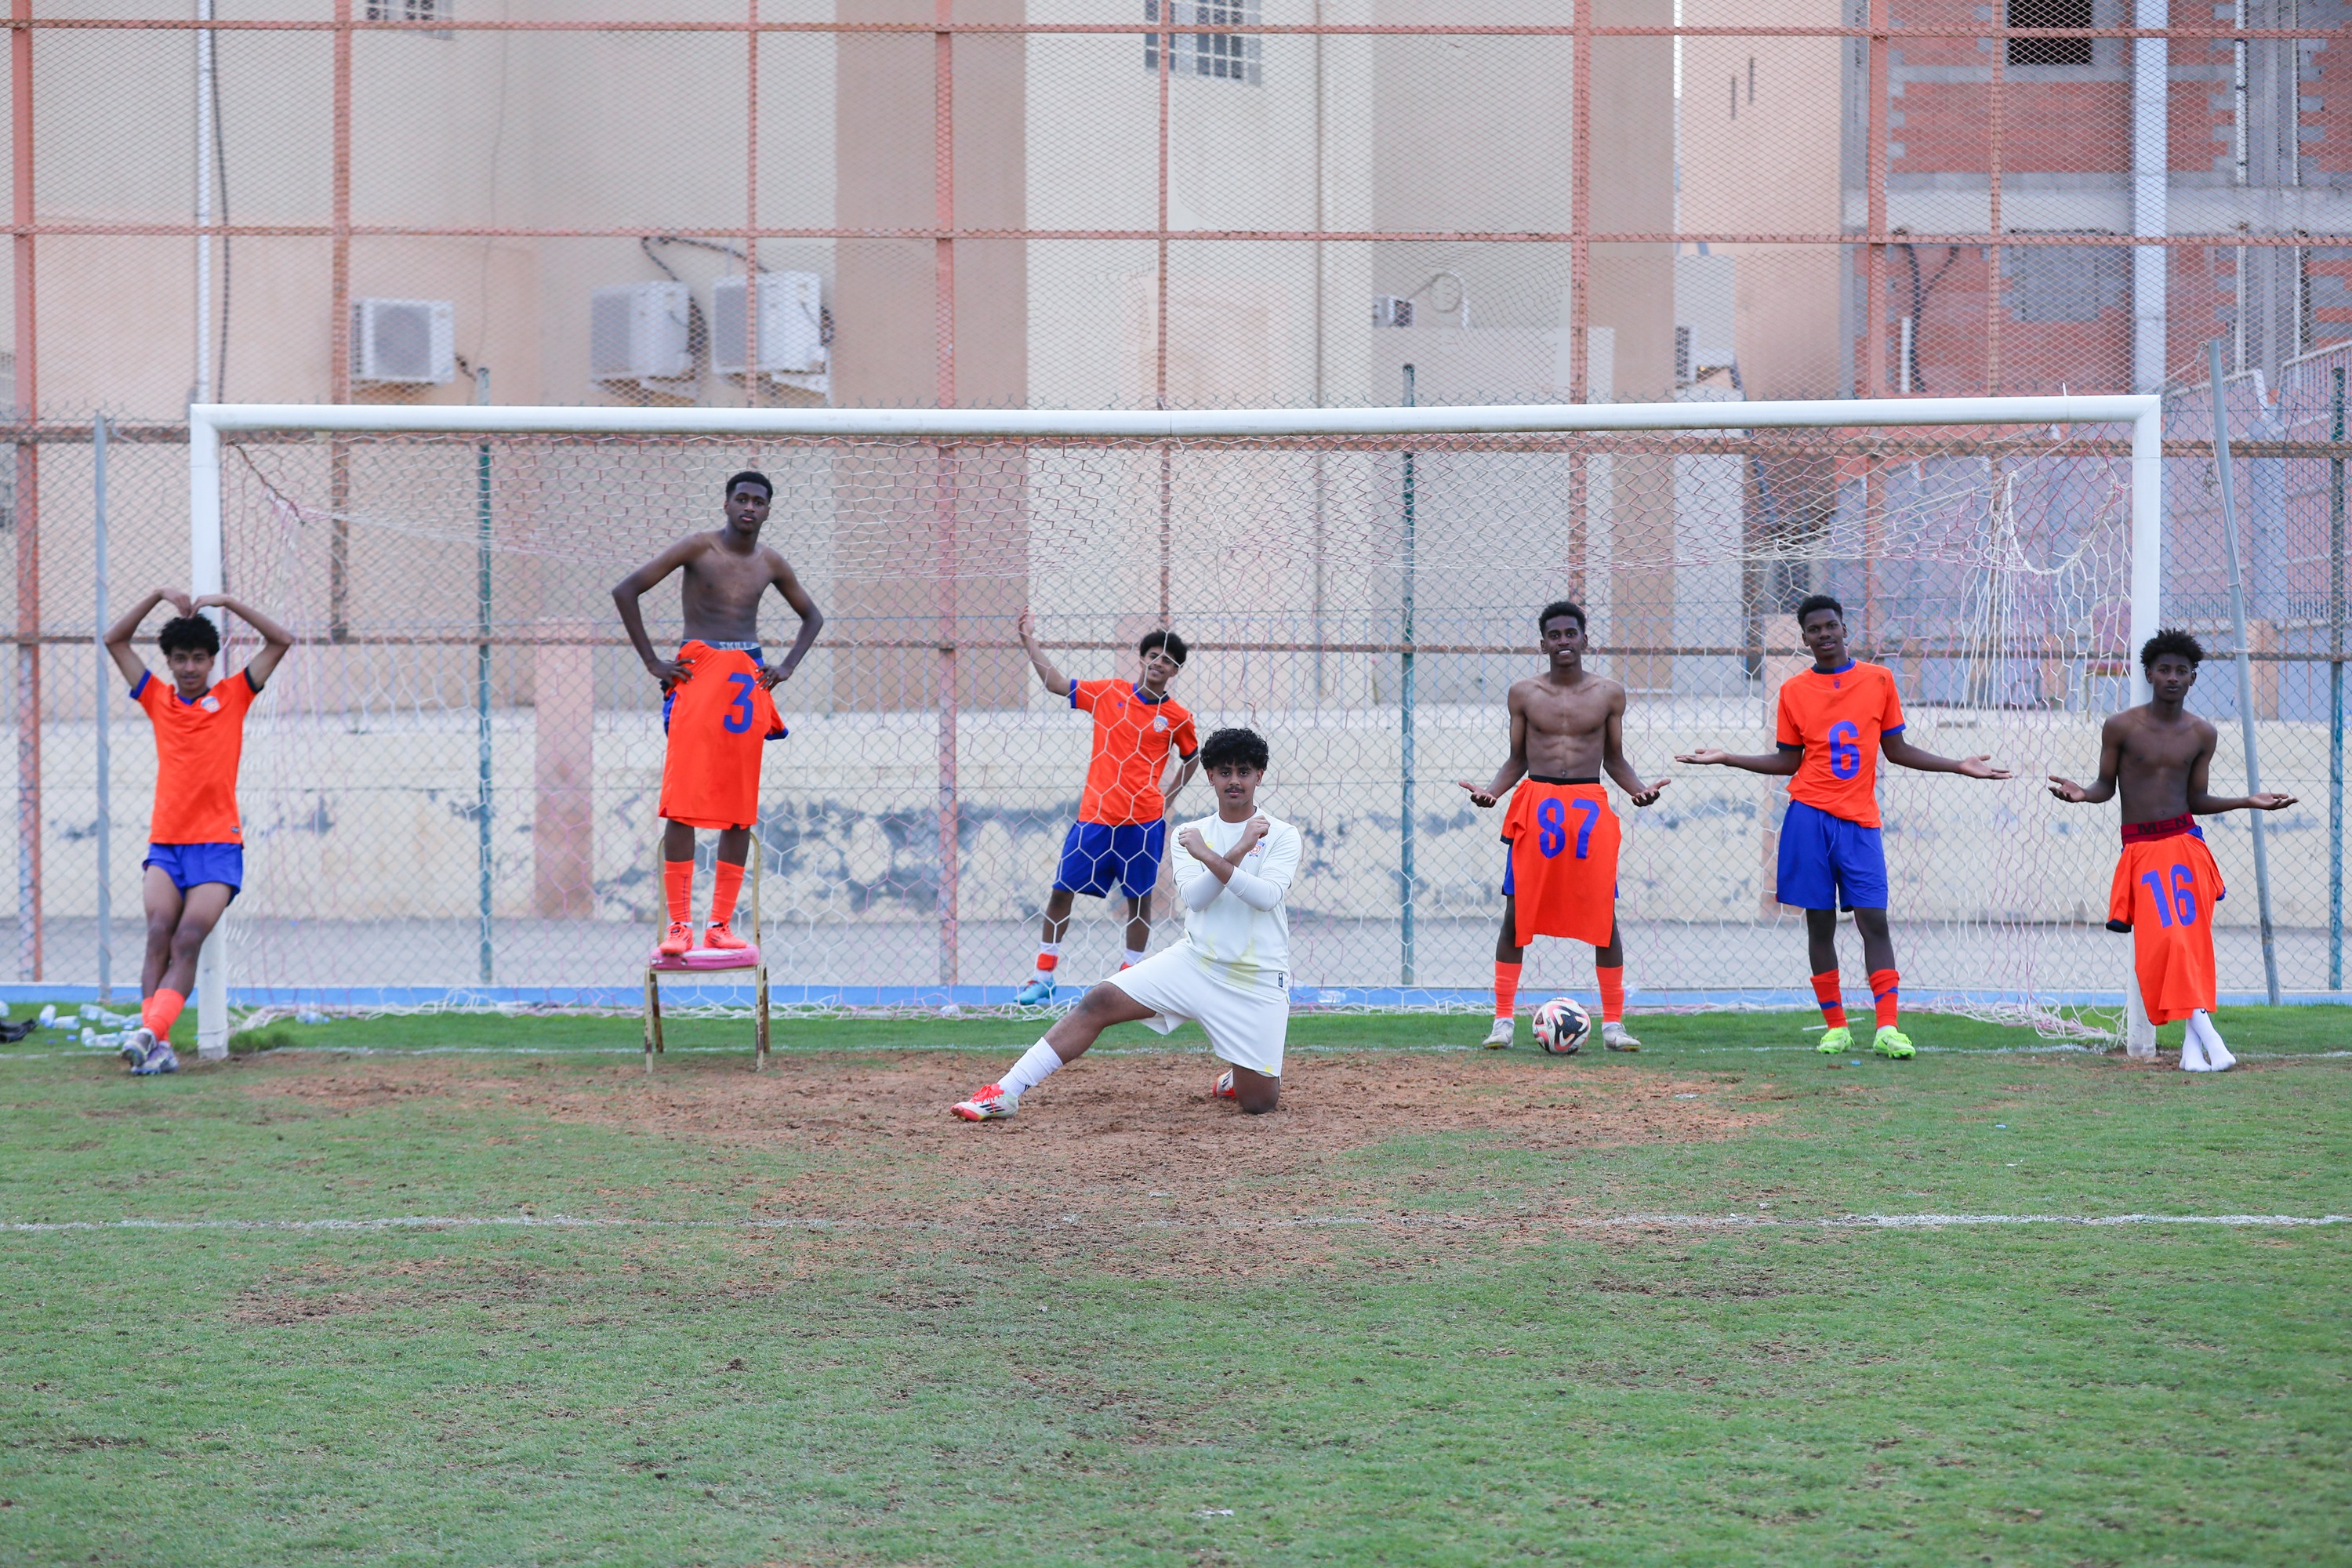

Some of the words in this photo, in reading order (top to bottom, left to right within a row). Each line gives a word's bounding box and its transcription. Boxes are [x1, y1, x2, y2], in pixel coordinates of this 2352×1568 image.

[723, 672, 757, 734] 3
[1828, 720, 1861, 780] 6
[1537, 797, 1601, 859] 87
[2137, 815, 2188, 834] MEN
[2140, 863, 2197, 928] 16
